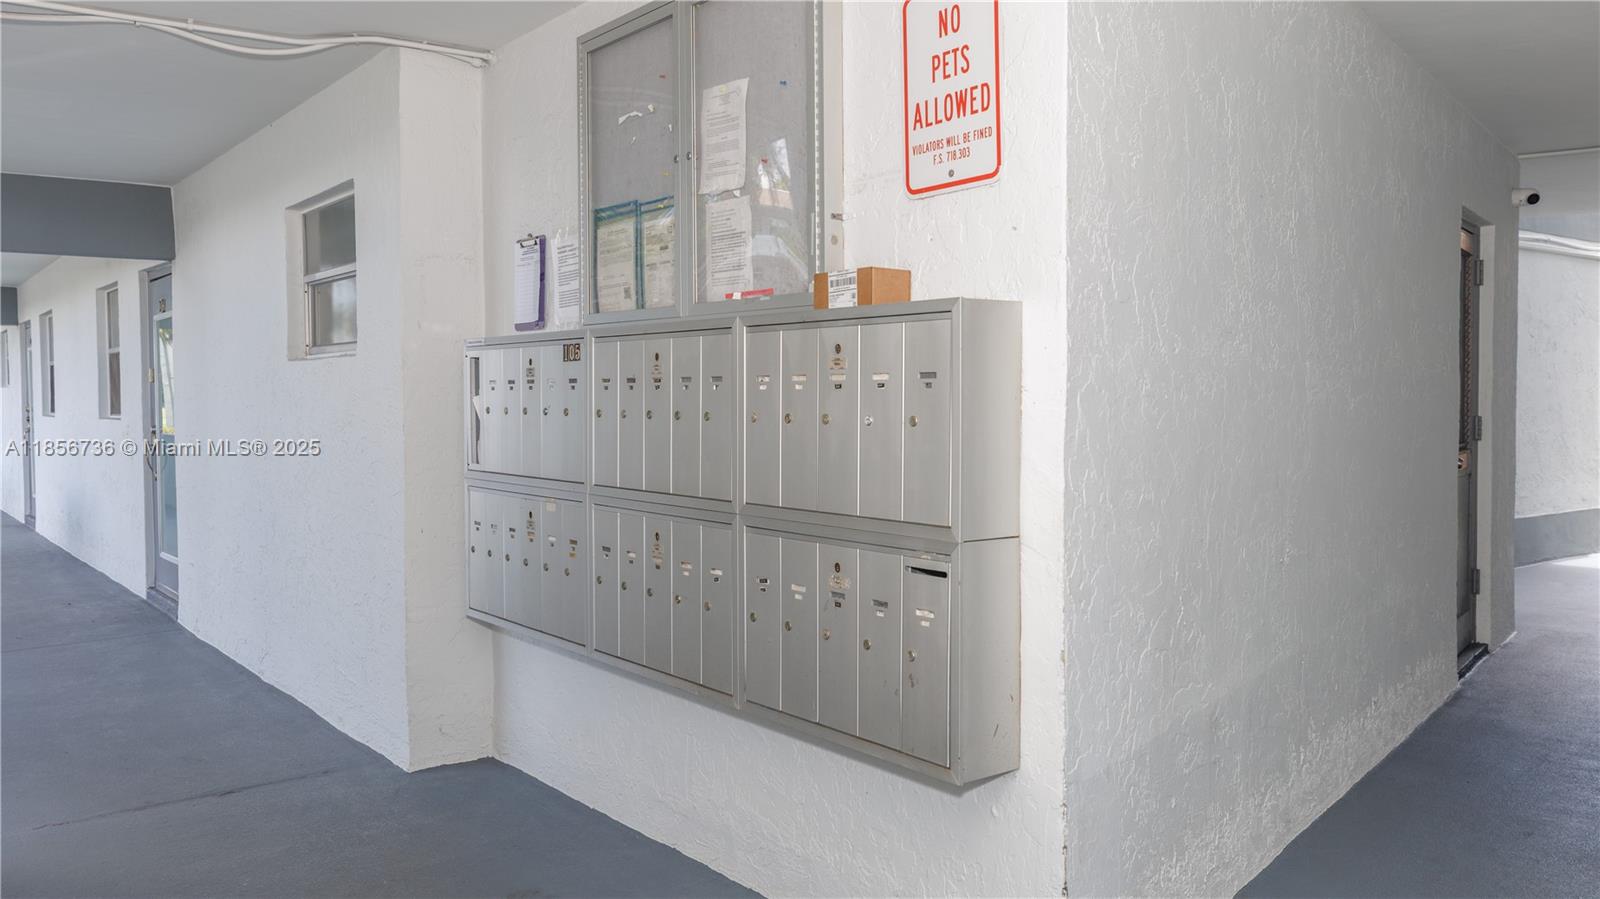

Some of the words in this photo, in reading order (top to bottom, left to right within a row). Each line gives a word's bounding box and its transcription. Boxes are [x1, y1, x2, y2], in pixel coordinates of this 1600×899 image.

[938, 4, 960, 38] NO
[931, 44, 970, 83] PETS
[913, 82, 990, 131] ALLOWED
[912, 138, 944, 156] VIOLATORS
[946, 133, 960, 147] WILL
[962, 131, 971, 143] BE
[973, 126, 993, 141] FINED
[933, 153, 944, 165] F.S.
[946, 147, 970, 162] 718.303
[564, 344, 580, 362] 105
